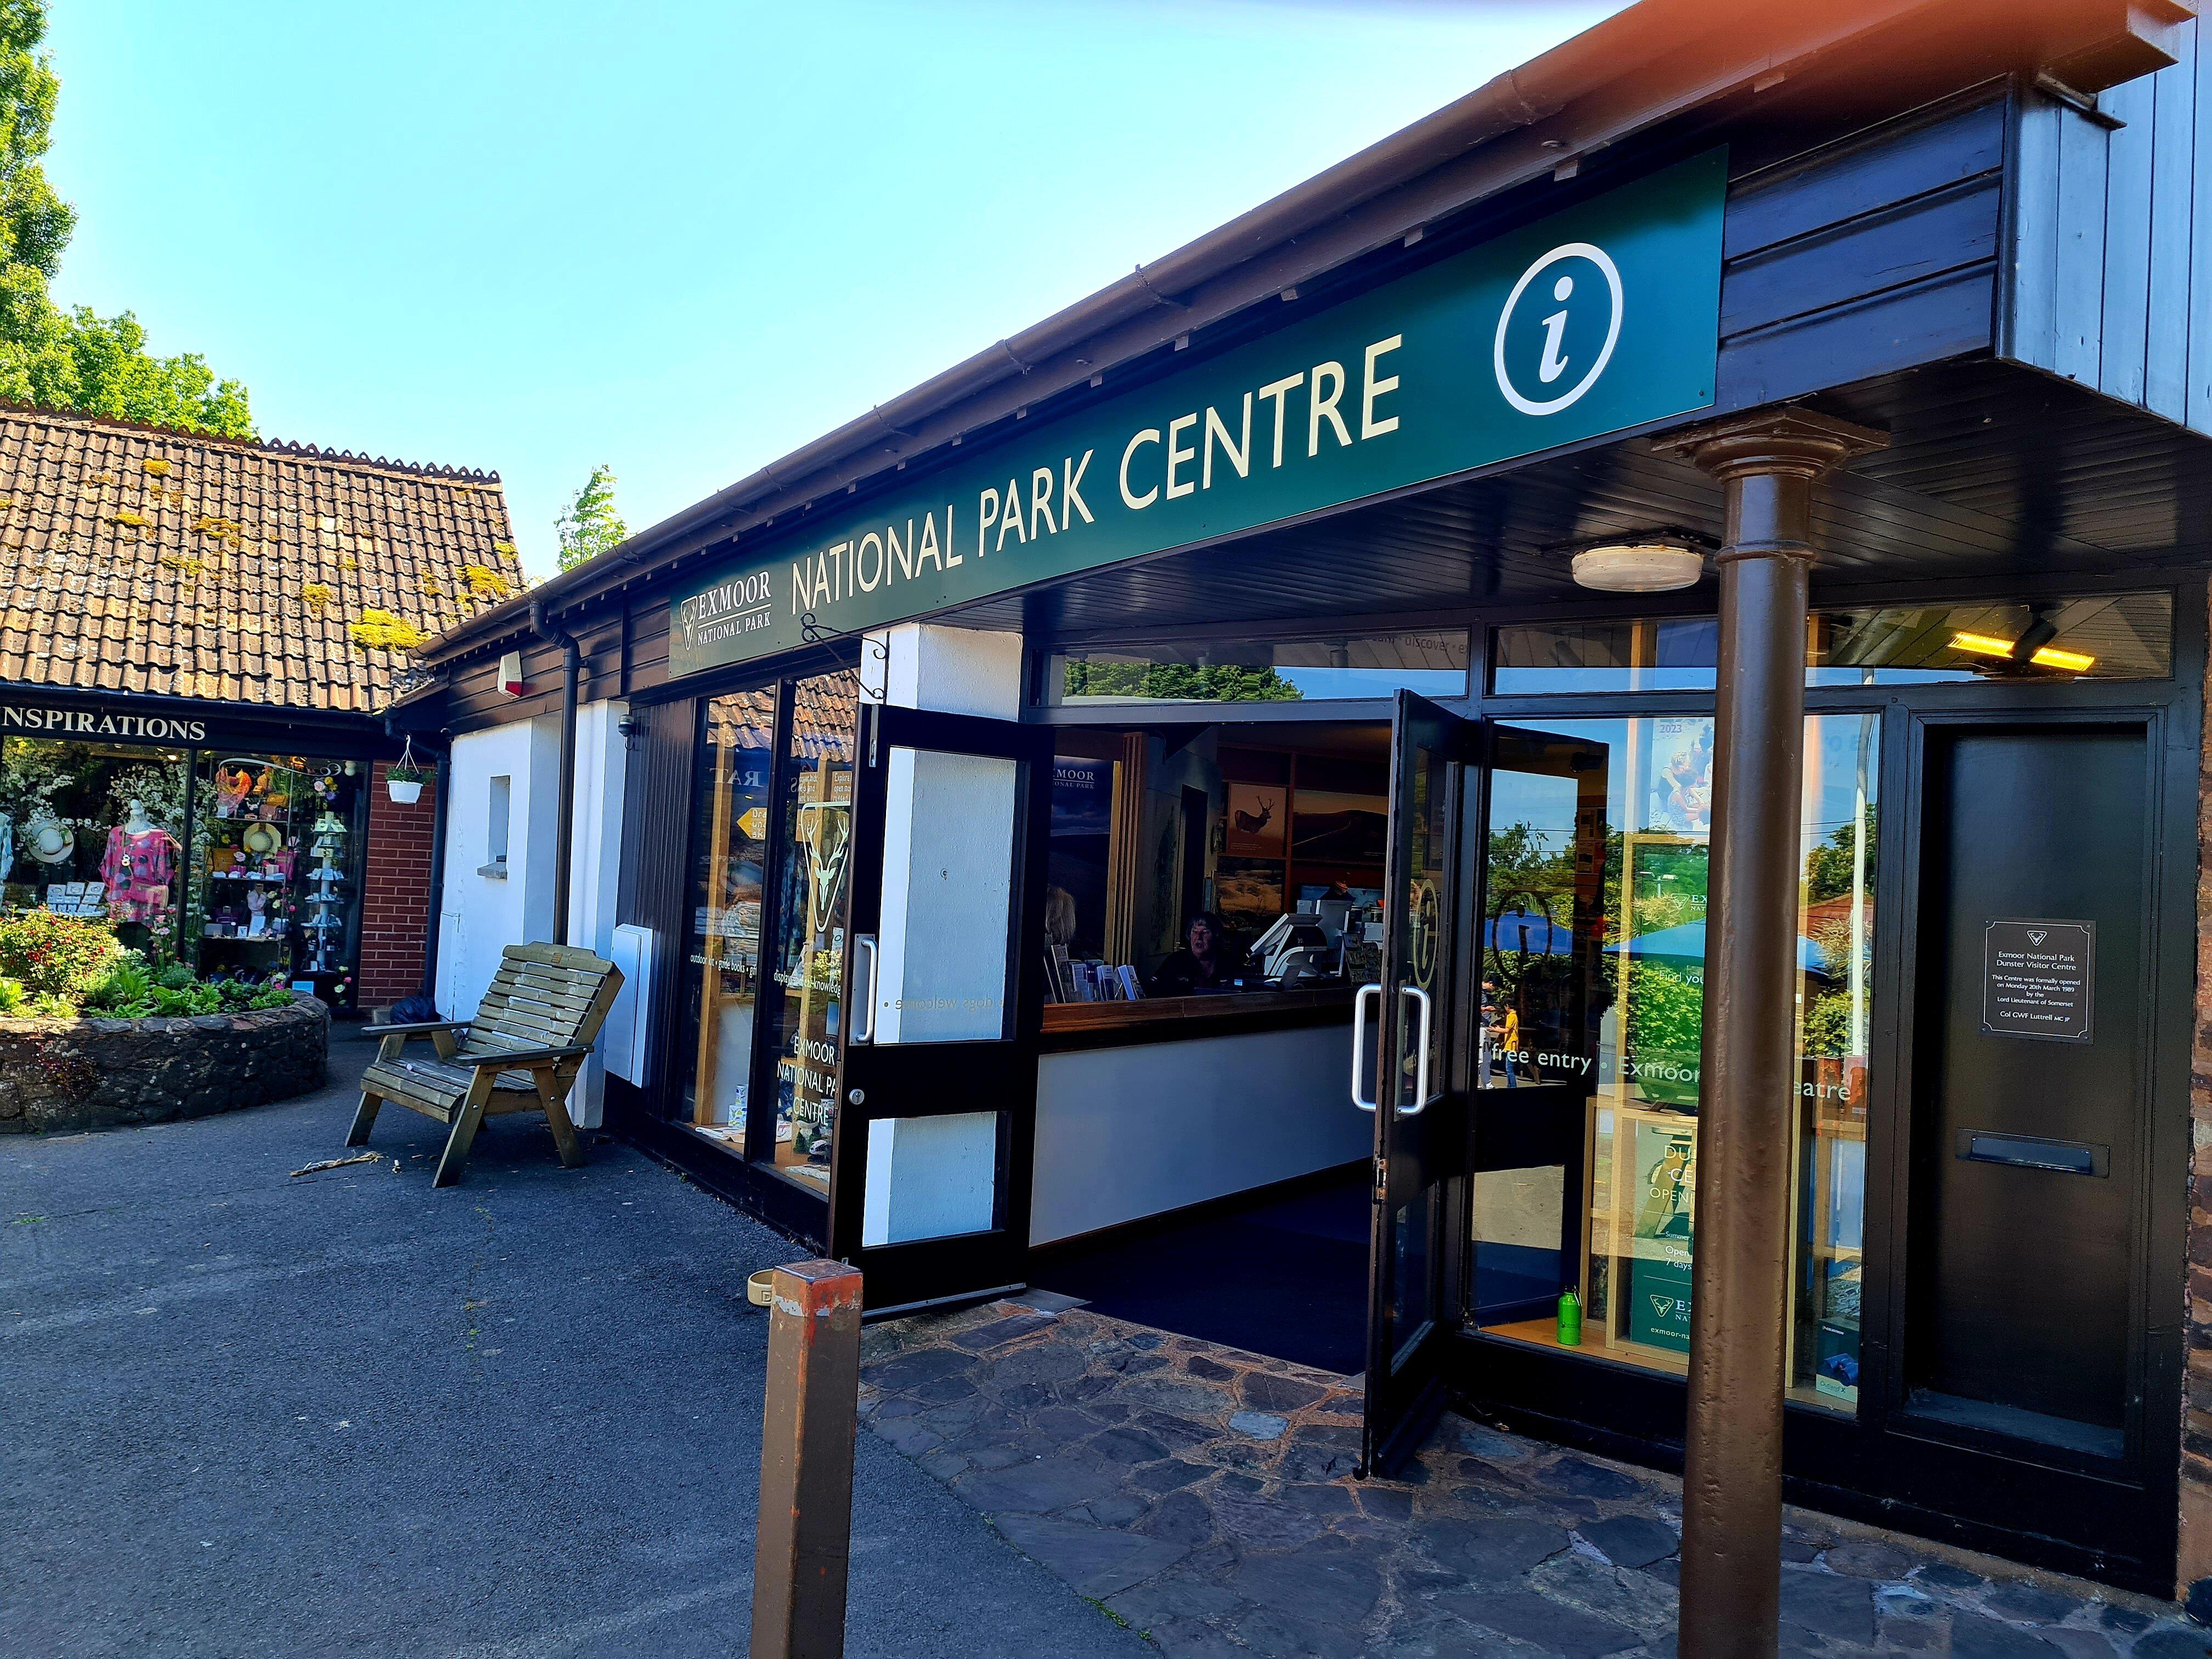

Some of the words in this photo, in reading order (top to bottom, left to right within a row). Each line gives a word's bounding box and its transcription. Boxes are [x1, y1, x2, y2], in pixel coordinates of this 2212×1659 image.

[792, 505, 963, 615] NATIONAL
[978, 449, 1095, 558] PARK
[1119, 334, 1403, 510] CENTRE
[697, 570, 771, 620] EXMOOR
[697, 620, 741, 646] NATIONAL
[744, 611, 771, 631] PARK
[0, 706, 206, 741] NSPIRATIONS
[1660, 724, 1682, 733] 2023
[690, 953, 707, 964] outdoor
[718, 958, 731, 972] guide
[731, 959, 745, 973] books
[1996, 960, 2024, 968] Dunster
[2027, 961, 2050, 969] Visitor
[2051, 963, 2076, 971] Centre
[1660, 970, 1681, 982] Find
[2035, 977, 2058, 985] formally
[794, 1036, 834, 1065] EXMOOR
[1492, 1042, 1530, 1064] free
[1538, 1054, 1592, 1075] entry
[777, 1060, 823, 1093] NATIONAL
[793, 1096, 830, 1126] CENTRE
[1665, 1231, 1690, 1241] Summer
[1665, 1245, 1690, 1257] Open
[1666, 1257, 1671, 1266] 7
[1674, 1261, 1692, 1272] days
